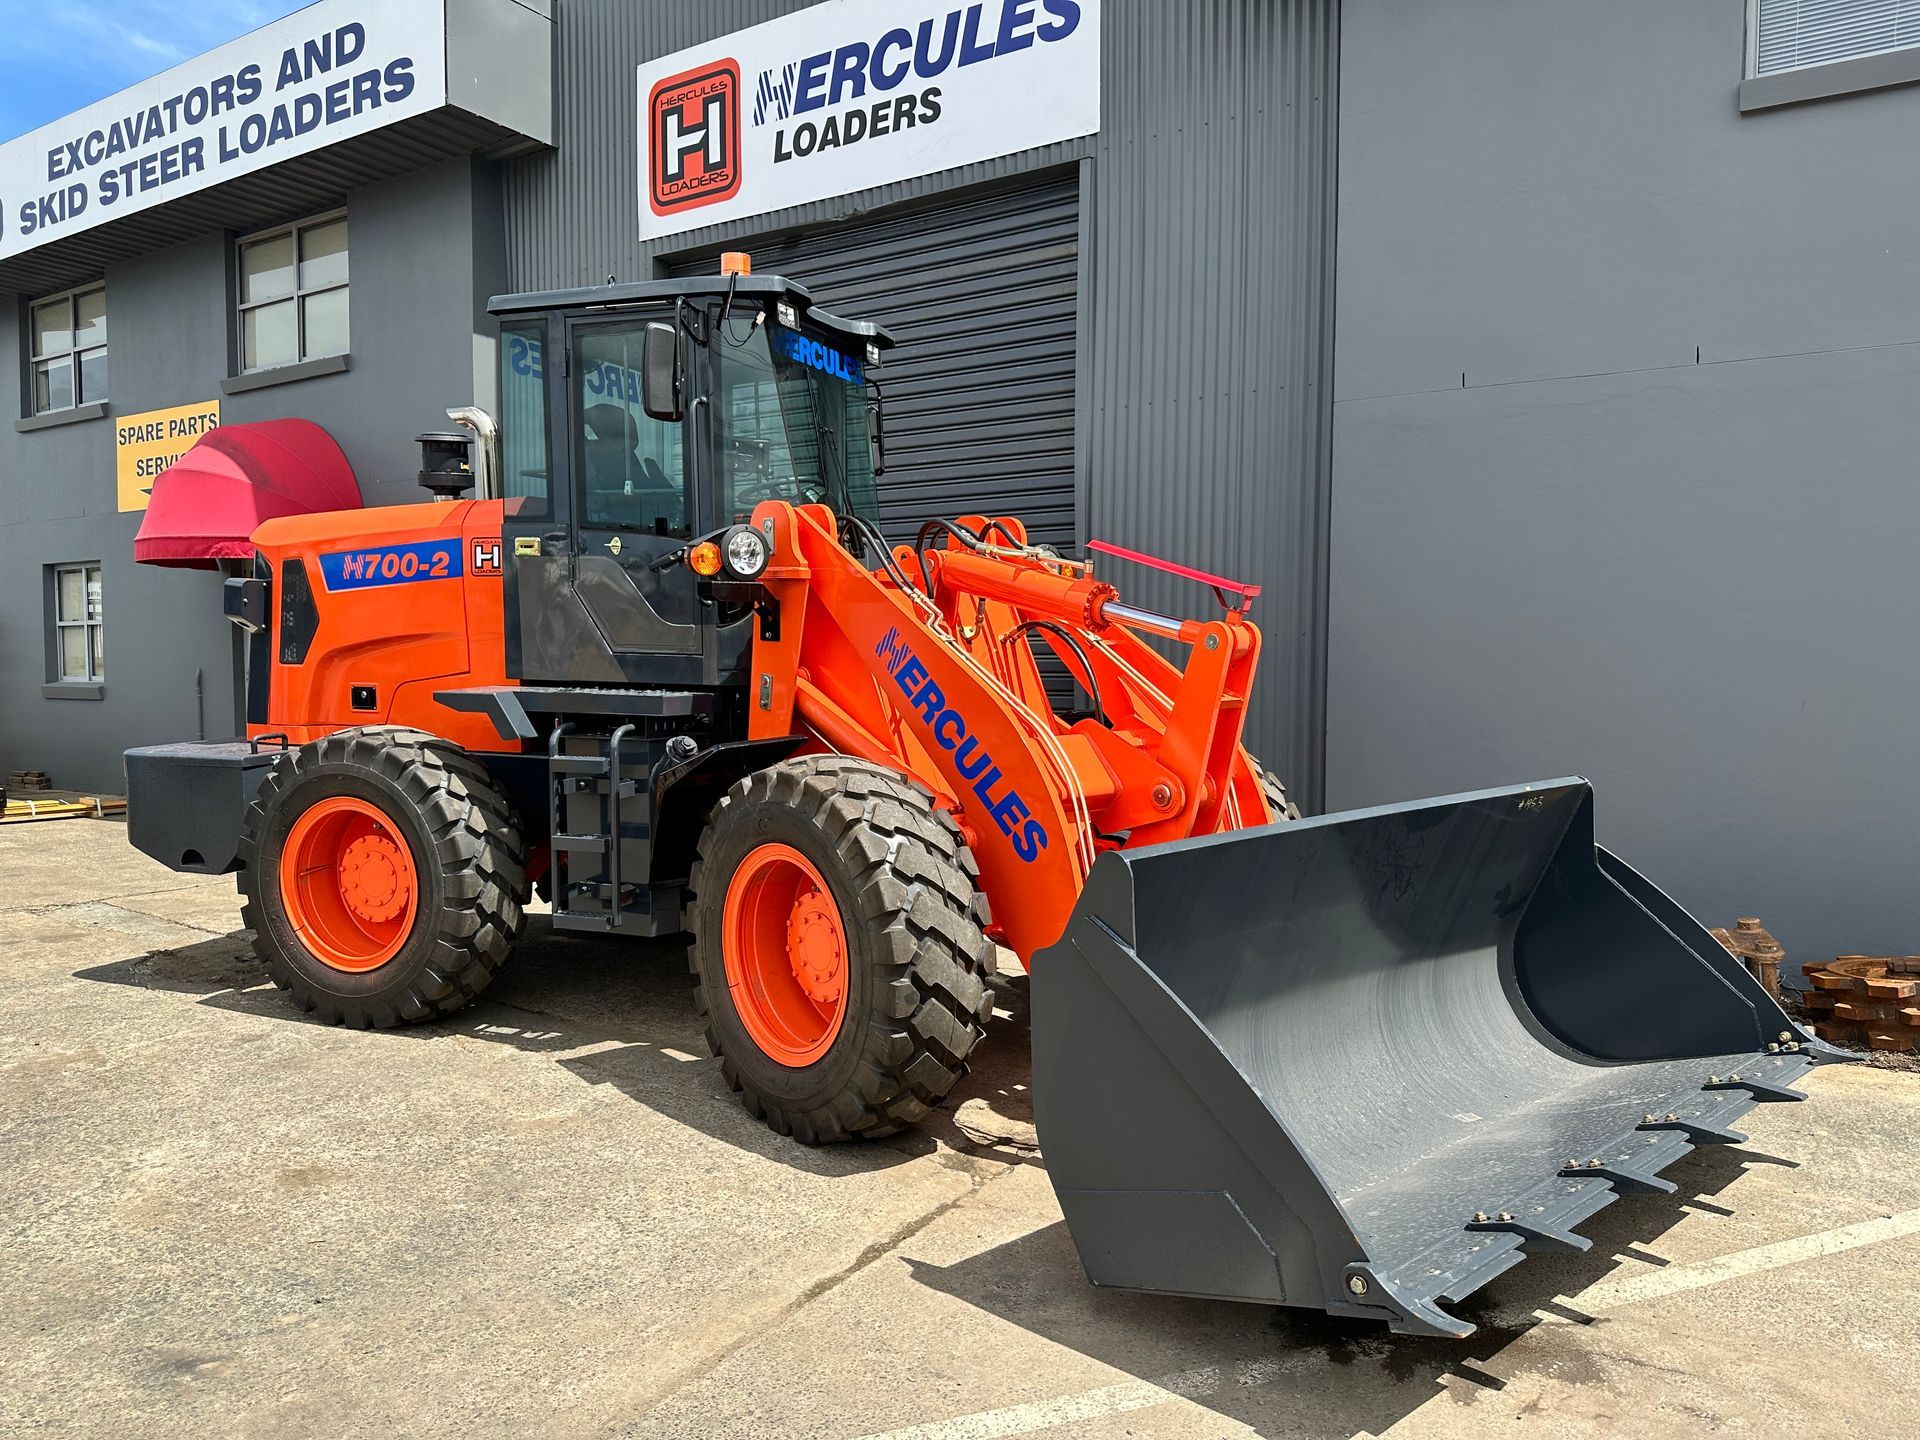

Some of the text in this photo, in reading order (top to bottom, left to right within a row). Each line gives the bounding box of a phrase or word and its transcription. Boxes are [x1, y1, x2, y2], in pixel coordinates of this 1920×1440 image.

[48, 22, 366, 182] EXCAVATORS AND
[660, 80, 728, 109] HERCULES
[752, 0, 1081, 128] HERCULES
[20, 57, 415, 235] SKID STEER LOADERS
[661, 91, 727, 185] H
[773, 86, 942, 164] LOADERS
[661, 170, 729, 196] LOADERS
[118, 412, 218, 446] SPARE PARTS
[342, 550, 450, 580] H700-2
[873, 625, 1049, 863] HERCULES
